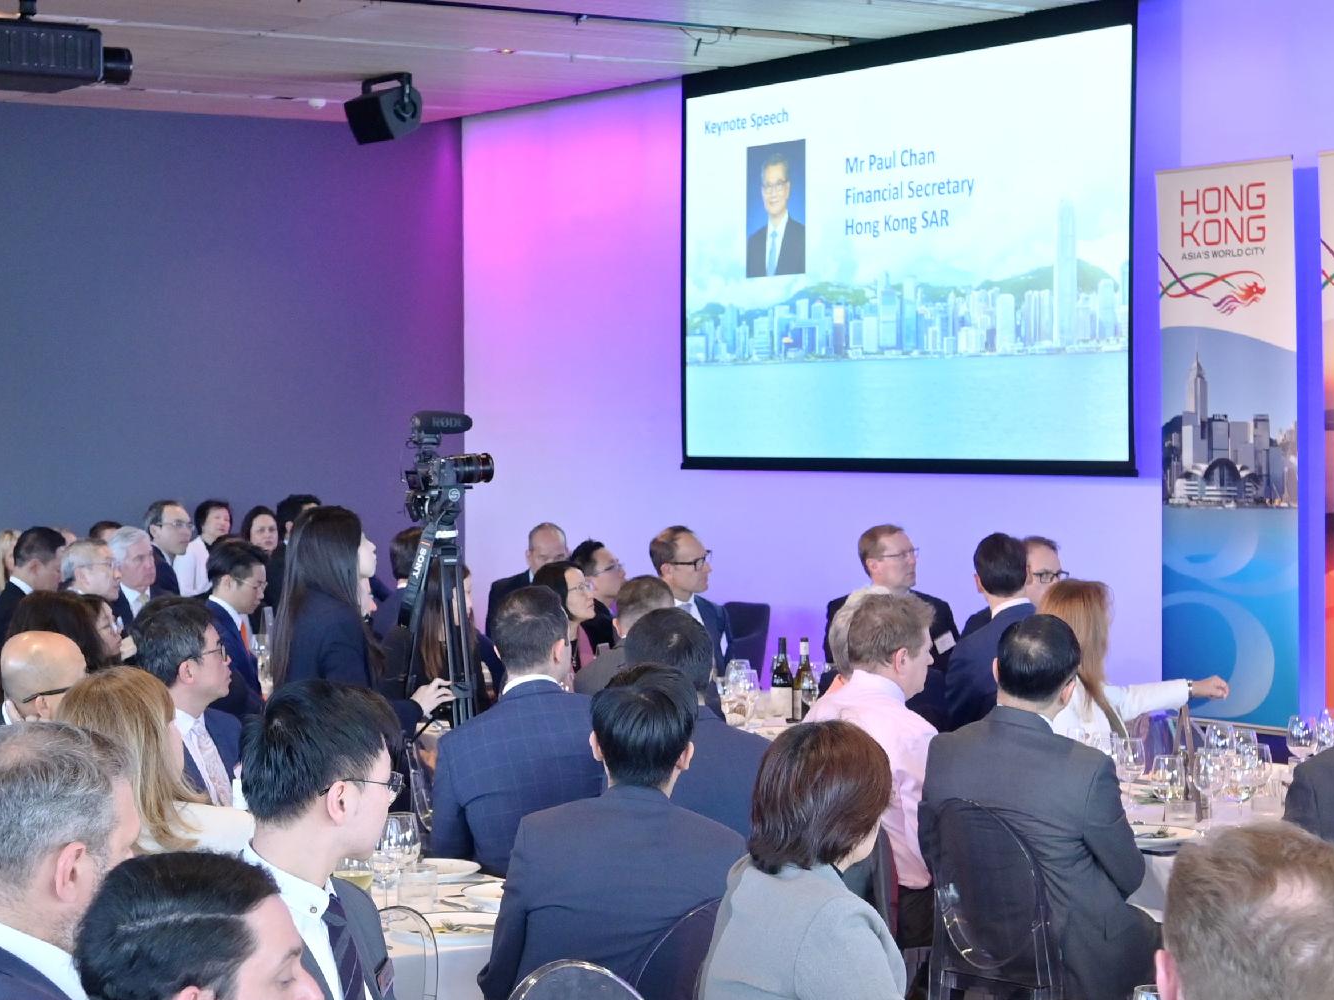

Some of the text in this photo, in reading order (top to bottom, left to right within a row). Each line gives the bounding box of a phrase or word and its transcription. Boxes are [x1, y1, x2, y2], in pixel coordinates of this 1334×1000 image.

[704, 108, 789, 136] Keynote Speech
[845, 148, 936, 175] Mr Paul Chan
[845, 176, 975, 205] Financial Secretary
[1180, 181, 1266, 218] HONG
[845, 210, 950, 239] Hong Kong SAR
[1180, 215, 1266, 248] KONG
[1181, 246, 1265, 261] ASIA'S WORLD CITY
[413, 548, 427, 579] SONY
